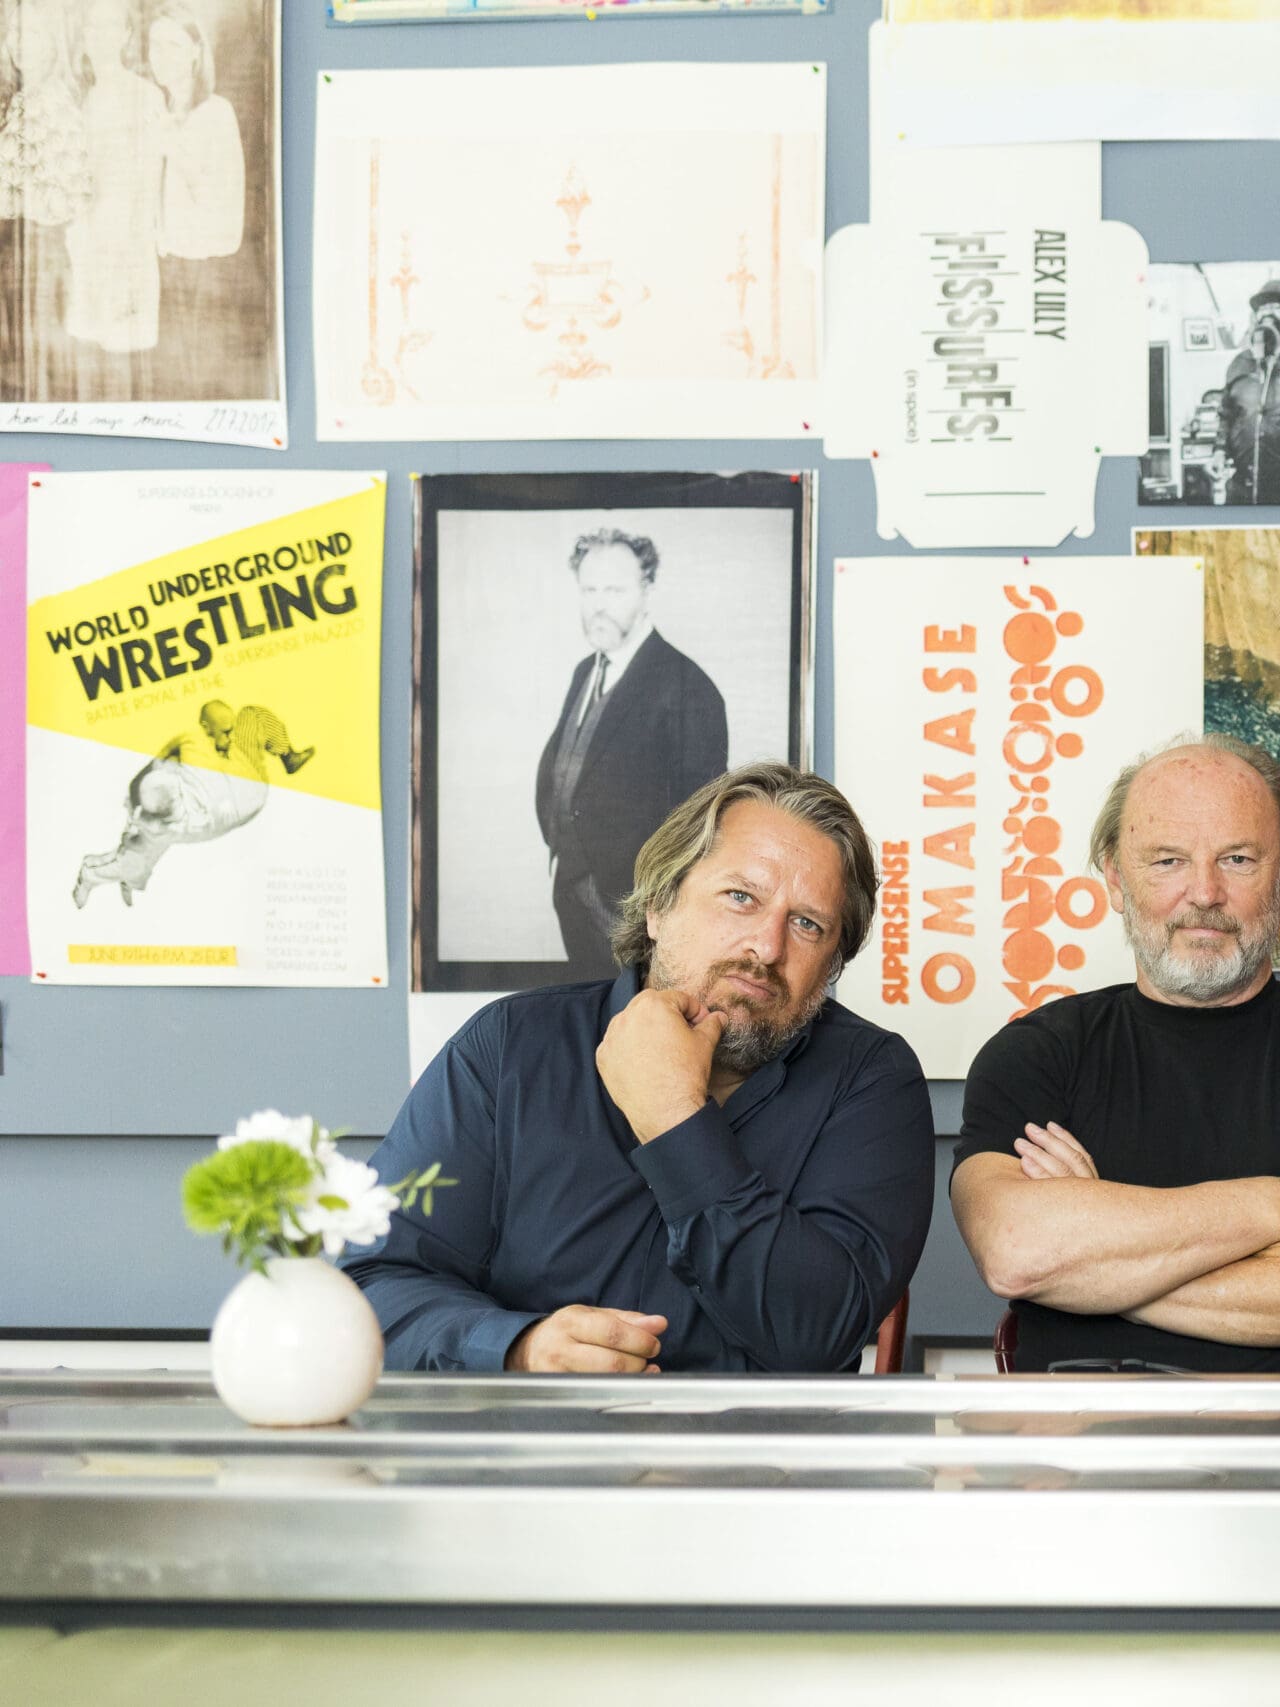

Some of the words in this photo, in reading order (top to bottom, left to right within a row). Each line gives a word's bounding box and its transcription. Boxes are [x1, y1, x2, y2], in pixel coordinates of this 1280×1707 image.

[1033, 229, 1067, 283] ALEX
[1033, 292, 1067, 341] LILLY
[932, 237, 1013, 437] FISSURES
[904, 391, 920, 443] space)
[46, 606, 151, 655] WORLD
[148, 531, 353, 607] UNDERGROUND
[72, 564, 358, 702] WRESTLING
[86, 704, 130, 726] BATTLE
[133, 686, 177, 710] ROYAL
[200, 674, 225, 691] THE
[223, 636, 300, 669] SUPERSENSE
[303, 617, 366, 647] PALAZZO
[920, 622, 977, 1005] OMAKASE
[881, 840, 911, 1006] SUPERSENSE
